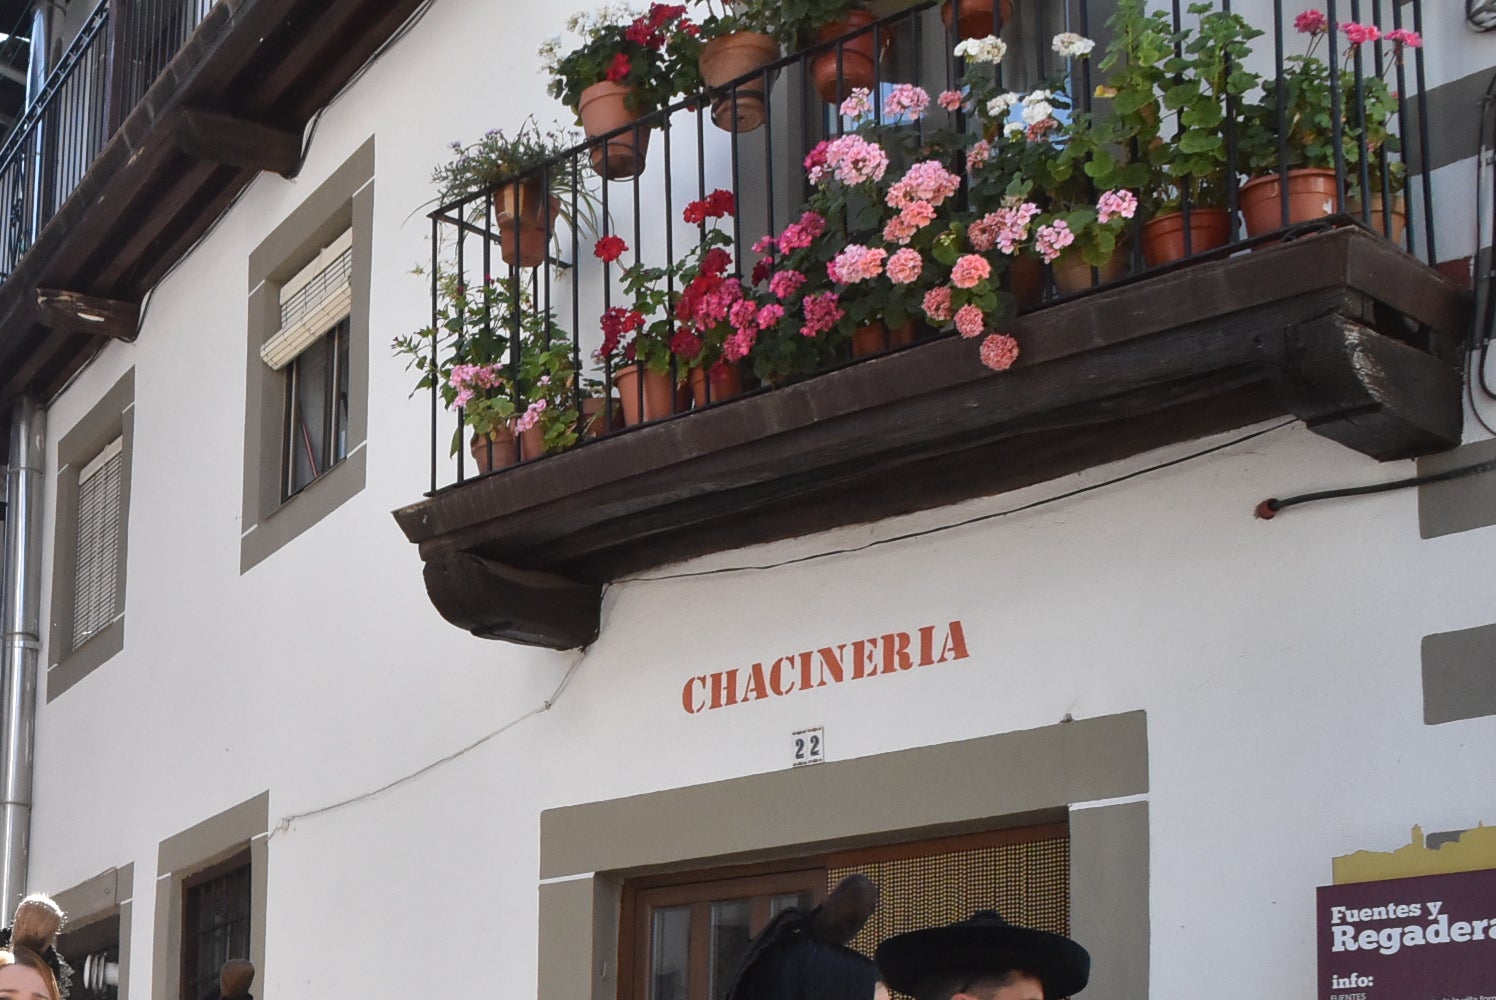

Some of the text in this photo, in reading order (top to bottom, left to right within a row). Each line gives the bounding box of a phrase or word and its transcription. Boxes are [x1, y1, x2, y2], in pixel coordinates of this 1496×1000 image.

[681, 620, 970, 714] CHACINERIA
[795, 735, 820, 759] 22
[1331, 901, 1443, 924] Fuentes y
[1332, 973, 1374, 989] info:
